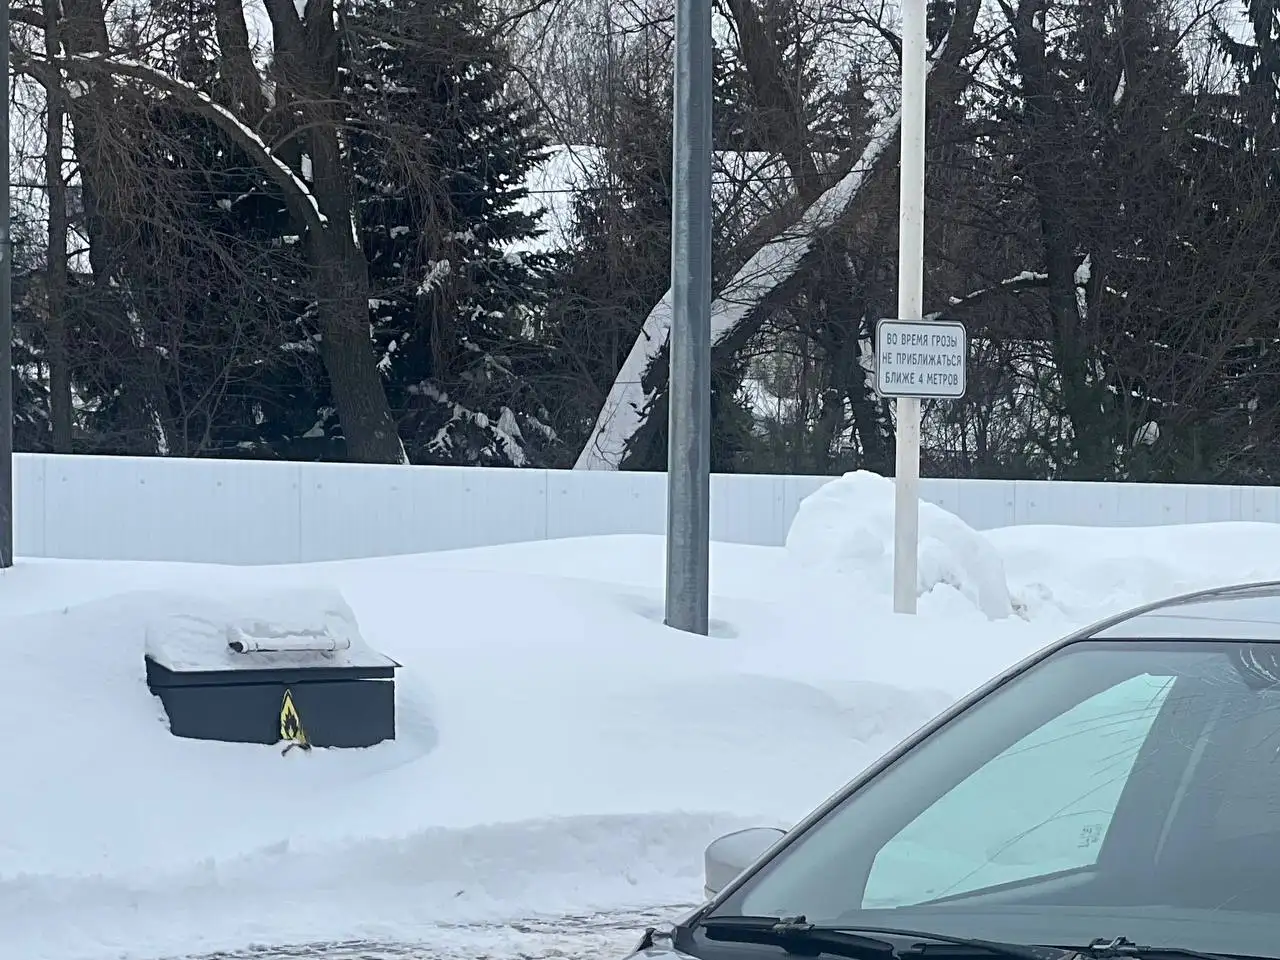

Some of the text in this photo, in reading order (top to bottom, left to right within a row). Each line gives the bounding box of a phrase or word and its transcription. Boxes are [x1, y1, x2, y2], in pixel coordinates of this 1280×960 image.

[886, 332, 957, 348] ВО ВРЕМЯ ГРОЗЫ
[882, 352, 961, 367] НЕ ПРИБЛИЖАТЬСЯ
[885, 371, 958, 386] БЛИЖЕ 4 МЕТРОВ
